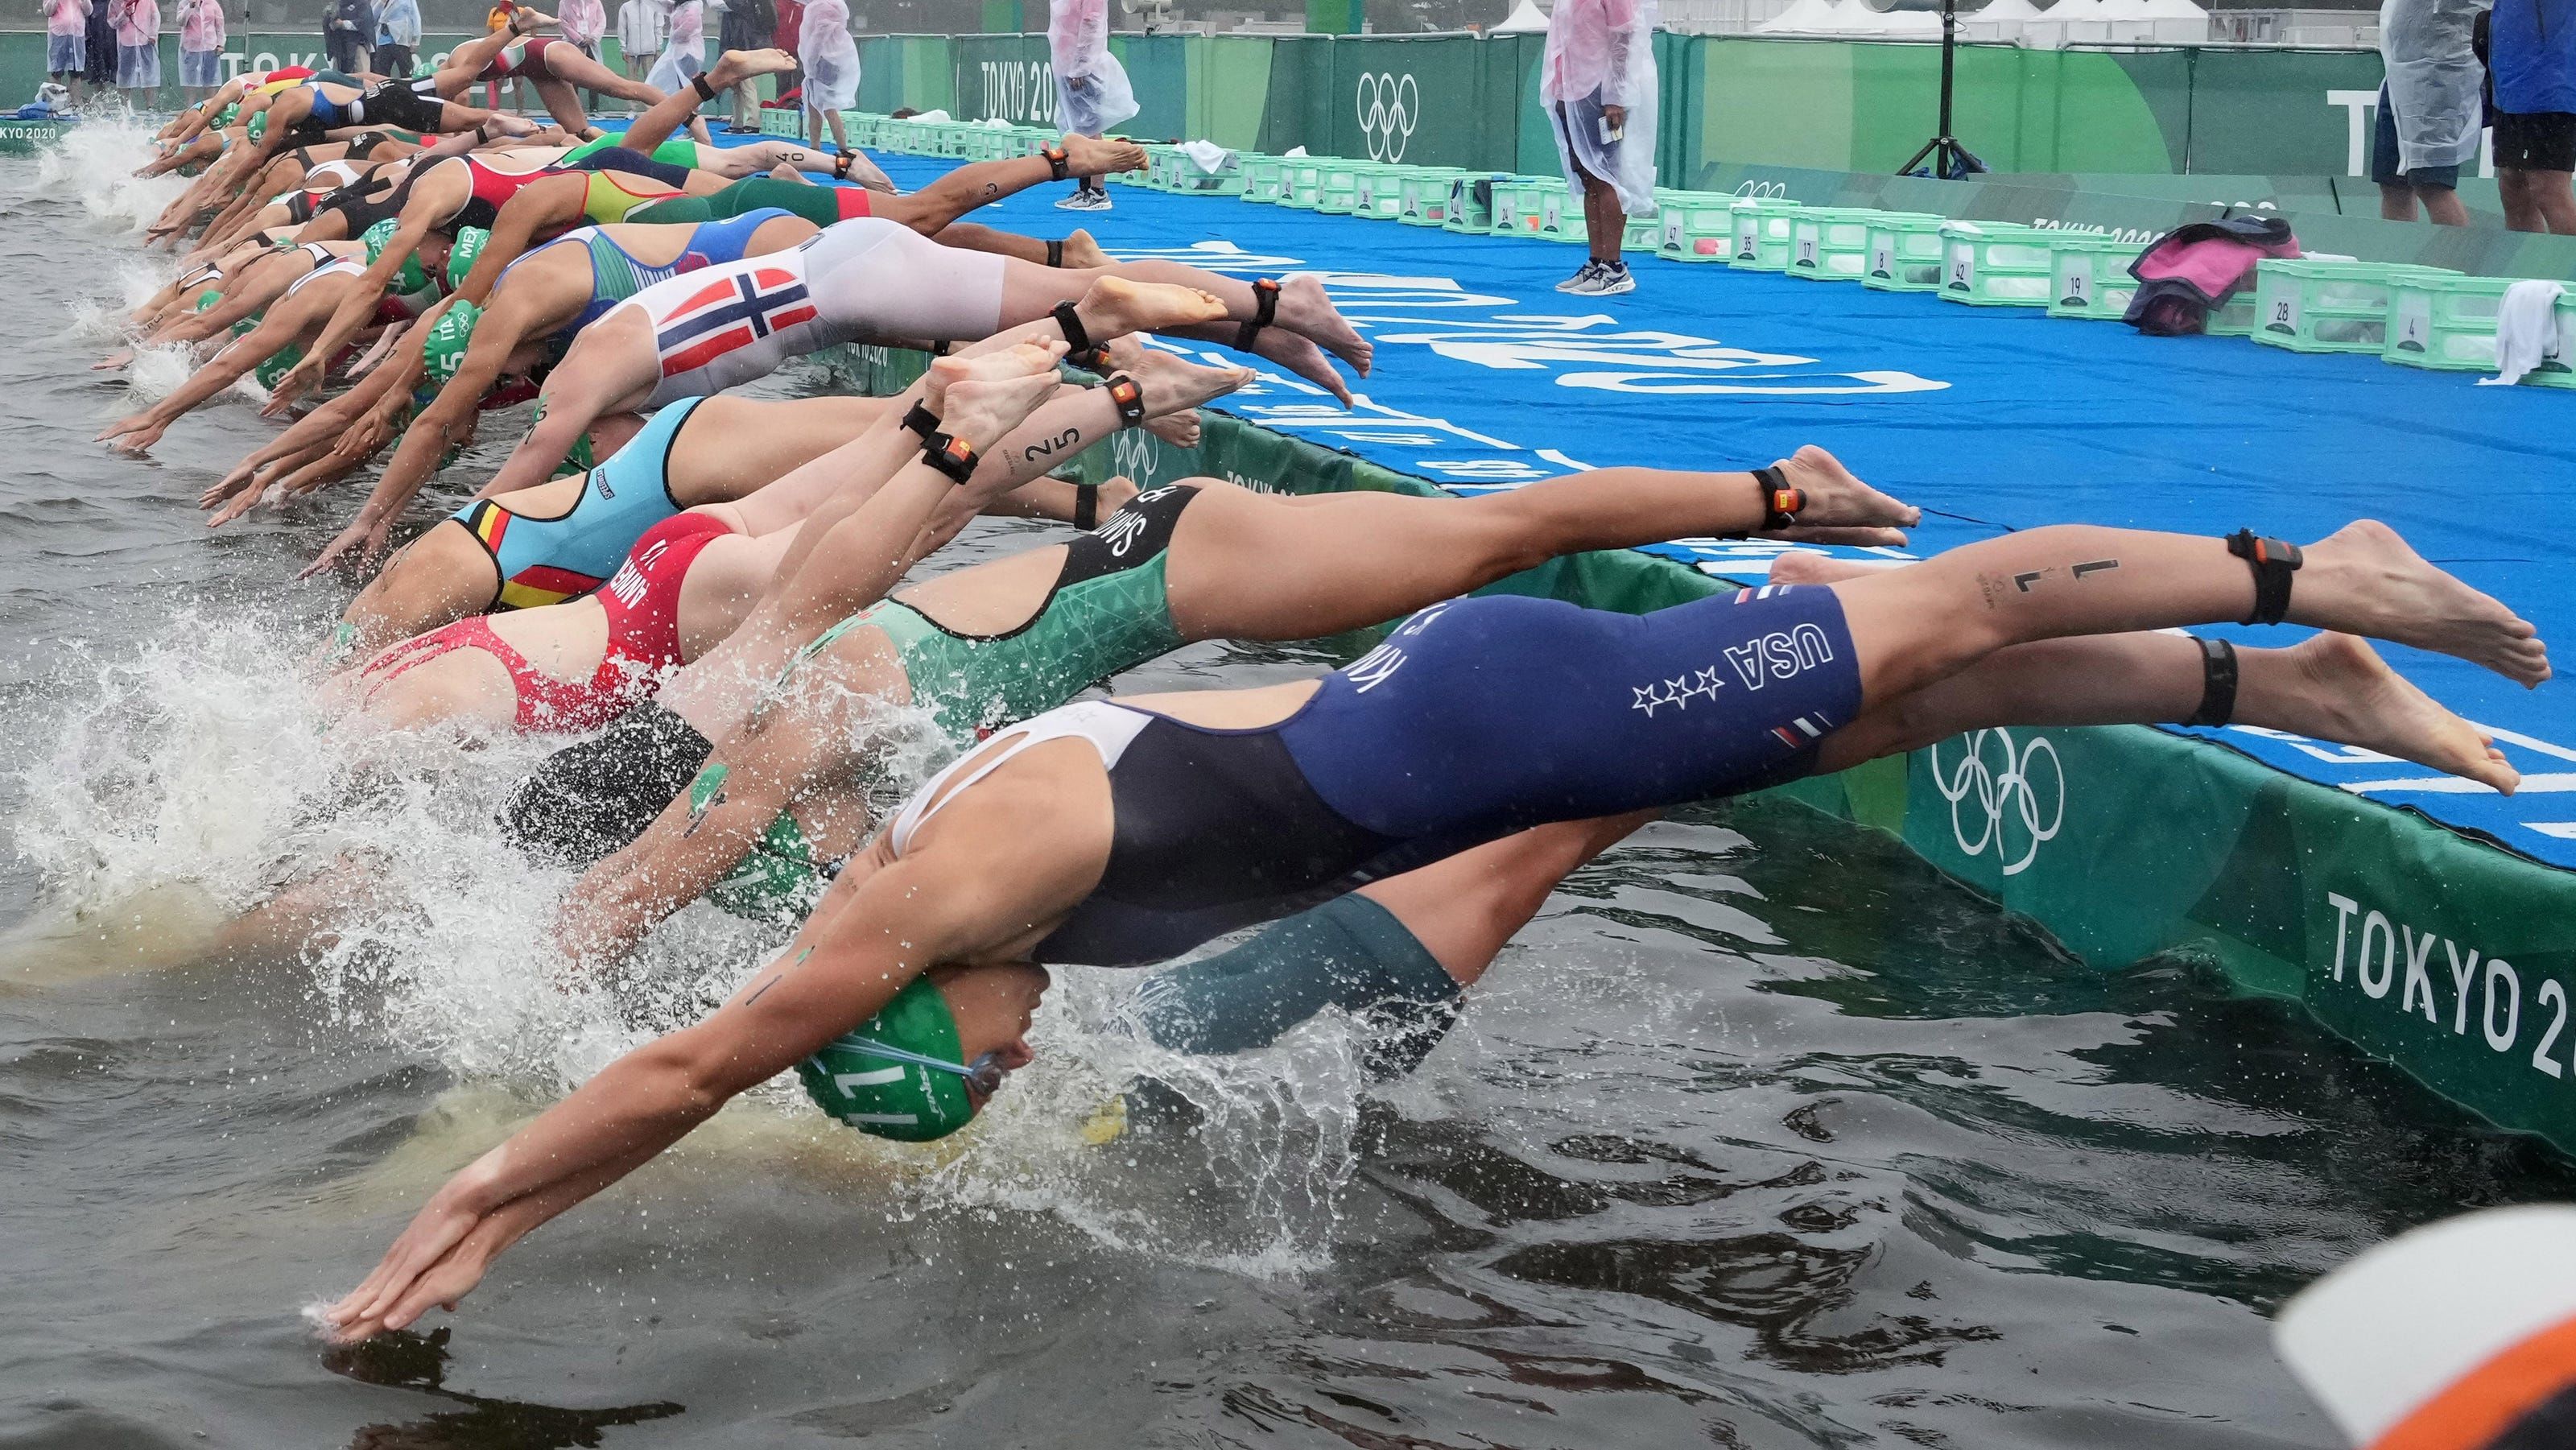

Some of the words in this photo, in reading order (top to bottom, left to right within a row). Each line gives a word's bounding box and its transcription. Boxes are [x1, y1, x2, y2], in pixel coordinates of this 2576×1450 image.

[981, 61, 1025, 121] TOKYO
[1030, 61, 1061, 124] 20
[26, 127, 56, 139] 2020
[775, 152, 805, 162] 40
[459, 228, 481, 258] MEX
[1669, 226, 1677, 241] 47
[1744, 236, 1752, 251] 35
[1803, 242, 1811, 258] 17
[1879, 252, 1885, 269] 8
[1955, 263, 1965, 280] 42
[2070, 277, 2081, 295] 19
[2277, 301, 2289, 322] 28
[440, 318, 456, 341] ITA
[2409, 317, 2415, 338] 4
[1025, 427, 1080, 462] 25
[1723, 623, 1834, 691] USA
[2328, 891, 2520, 1052] TOKYO
[2533, 978, 2576, 1079] 2
